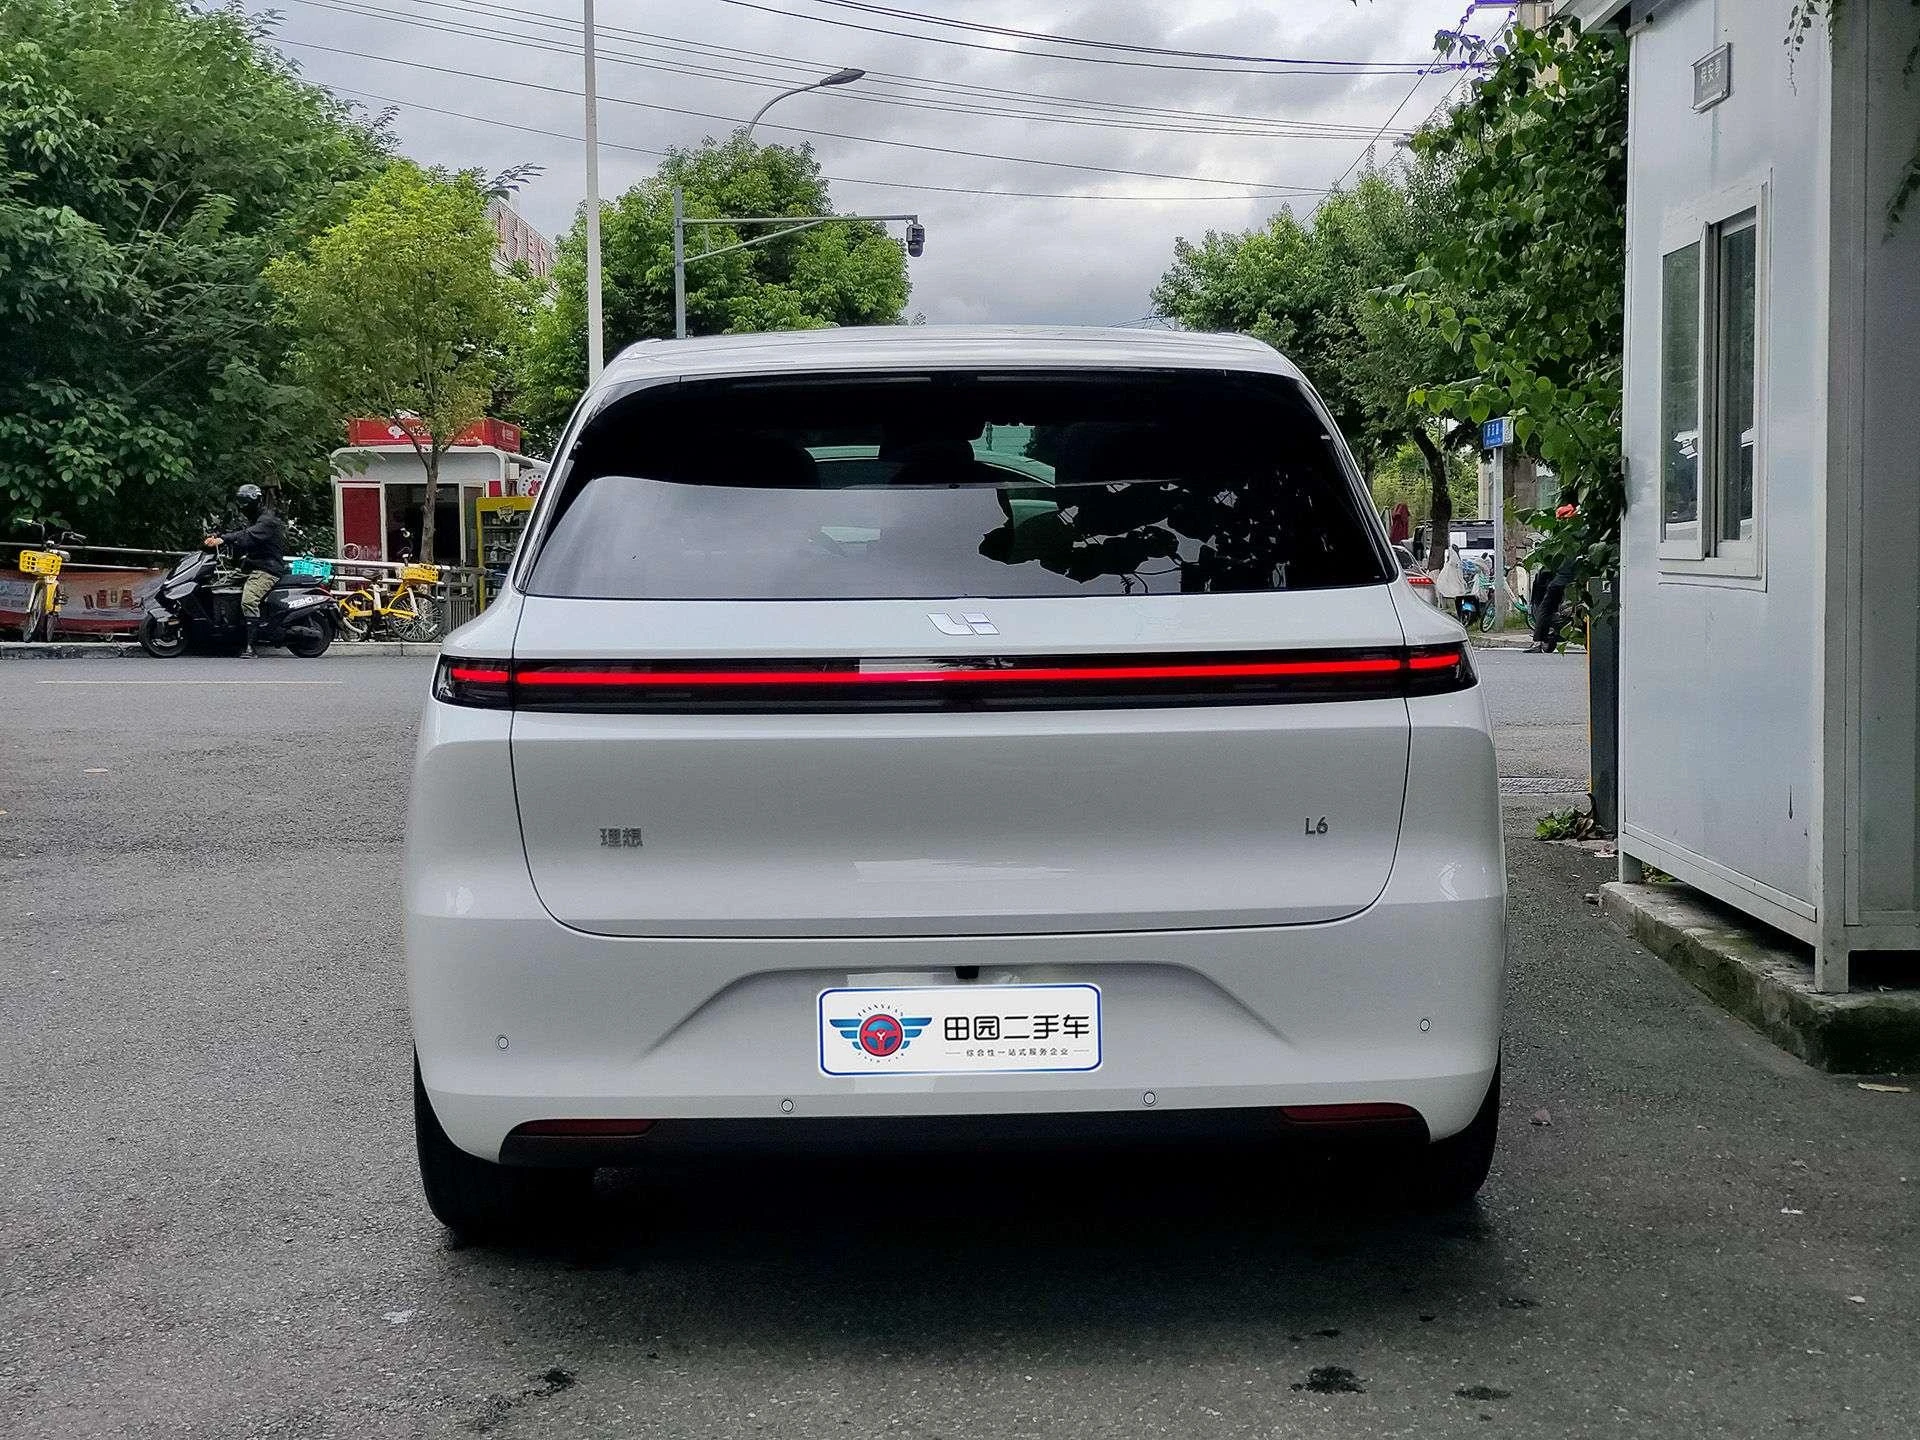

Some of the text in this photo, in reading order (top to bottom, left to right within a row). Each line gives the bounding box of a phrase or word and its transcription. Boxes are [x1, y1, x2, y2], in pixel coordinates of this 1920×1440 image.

[1305, 816, 1329, 835] L6
[600, 827, 643, 847] 理想
[944, 1014, 1090, 1041] 田园二手车
[966, 1047, 1069, 1057] 综合性一站式服务企业
